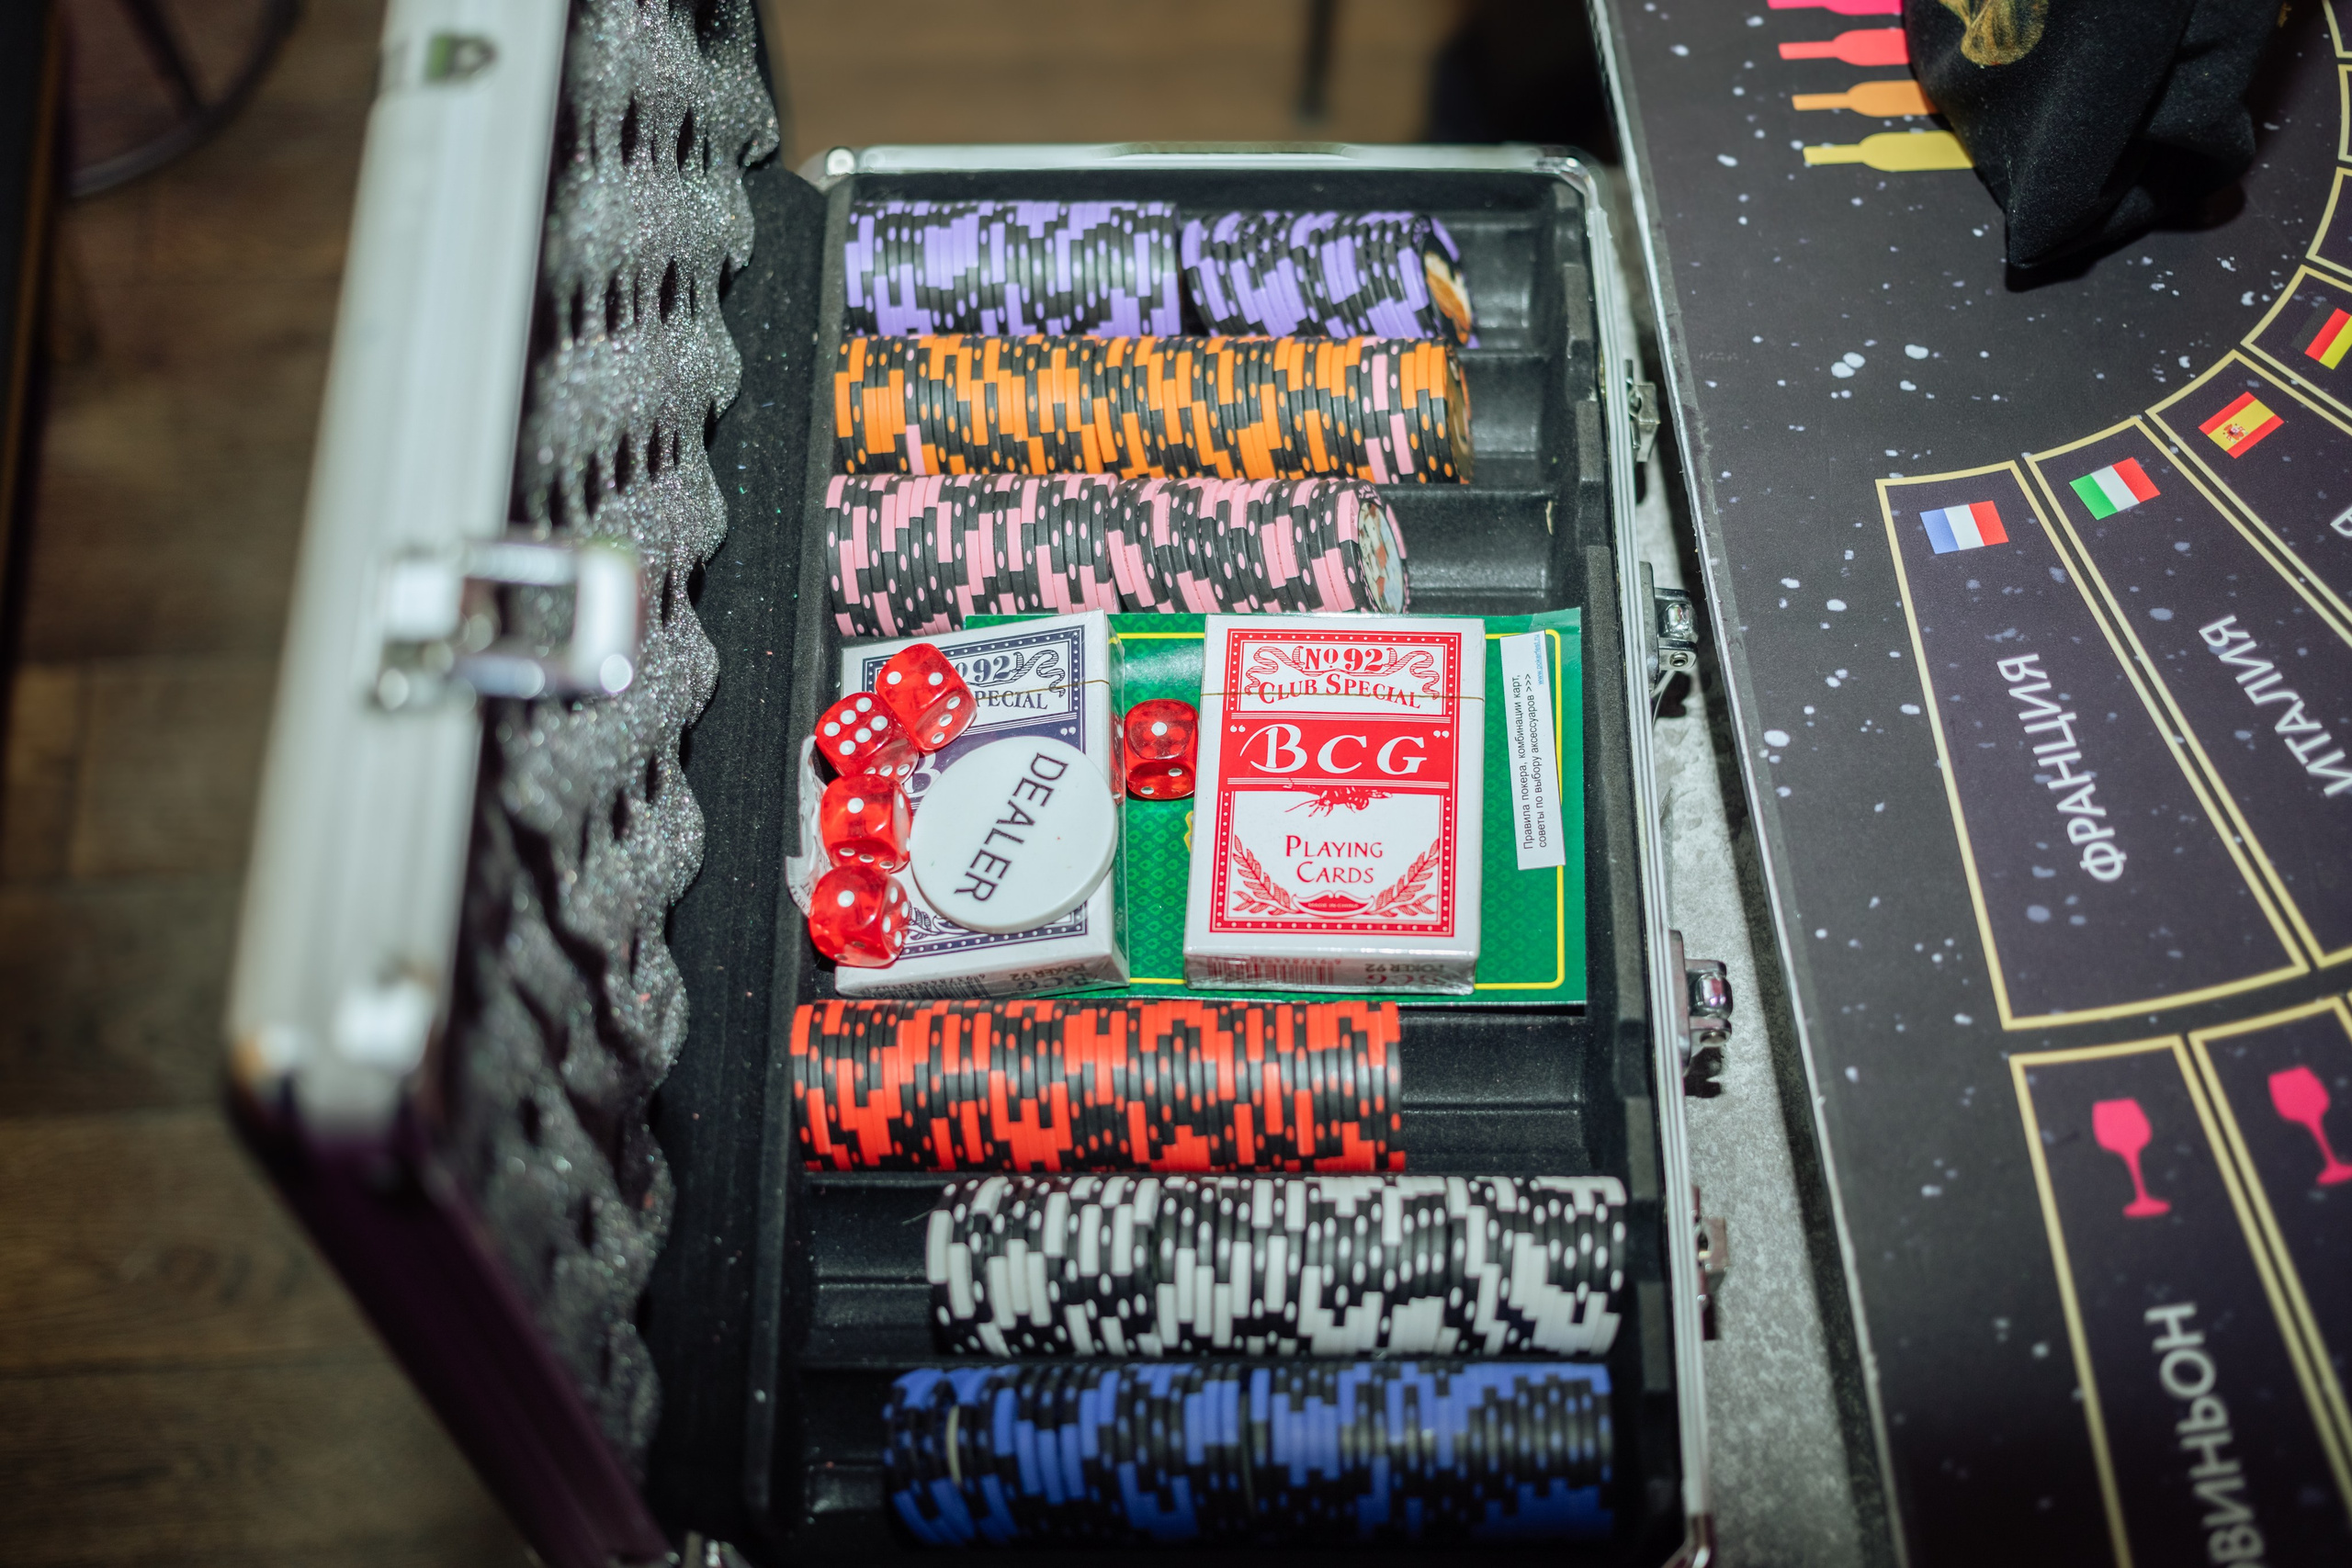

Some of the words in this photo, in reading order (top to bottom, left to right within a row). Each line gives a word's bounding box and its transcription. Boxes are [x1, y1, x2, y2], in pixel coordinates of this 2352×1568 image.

[972, 655, 1012, 683] 92
[1343, 648, 1385, 671] 92
[974, 690, 1048, 710] PECIAL
[1258, 679, 1317, 705] CLUB
[1326, 673, 1421, 709] SPECIAL
[1511, 674, 1523, 699] карт,
[1526, 694, 1539, 753] аксессуаров
[2198, 615, 2352, 798] ИТАЛИЯ
[1514, 701, 1526, 759] комбинации
[1519, 761, 1530, 800] покера,
[1531, 756, 1543, 794] выбору
[1996, 653, 2128, 883] ФРАНЦИЯ
[1535, 795, 1544, 808] по
[954, 752, 1069, 903] DEALER
[1523, 804, 1535, 850] Правила
[1535, 811, 1547, 848] советы
[1285, 835, 1384, 859] PLAYING
[1296, 861, 1374, 884] CARDS
[2143, 1302, 2266, 1568] ВИНЬОН
